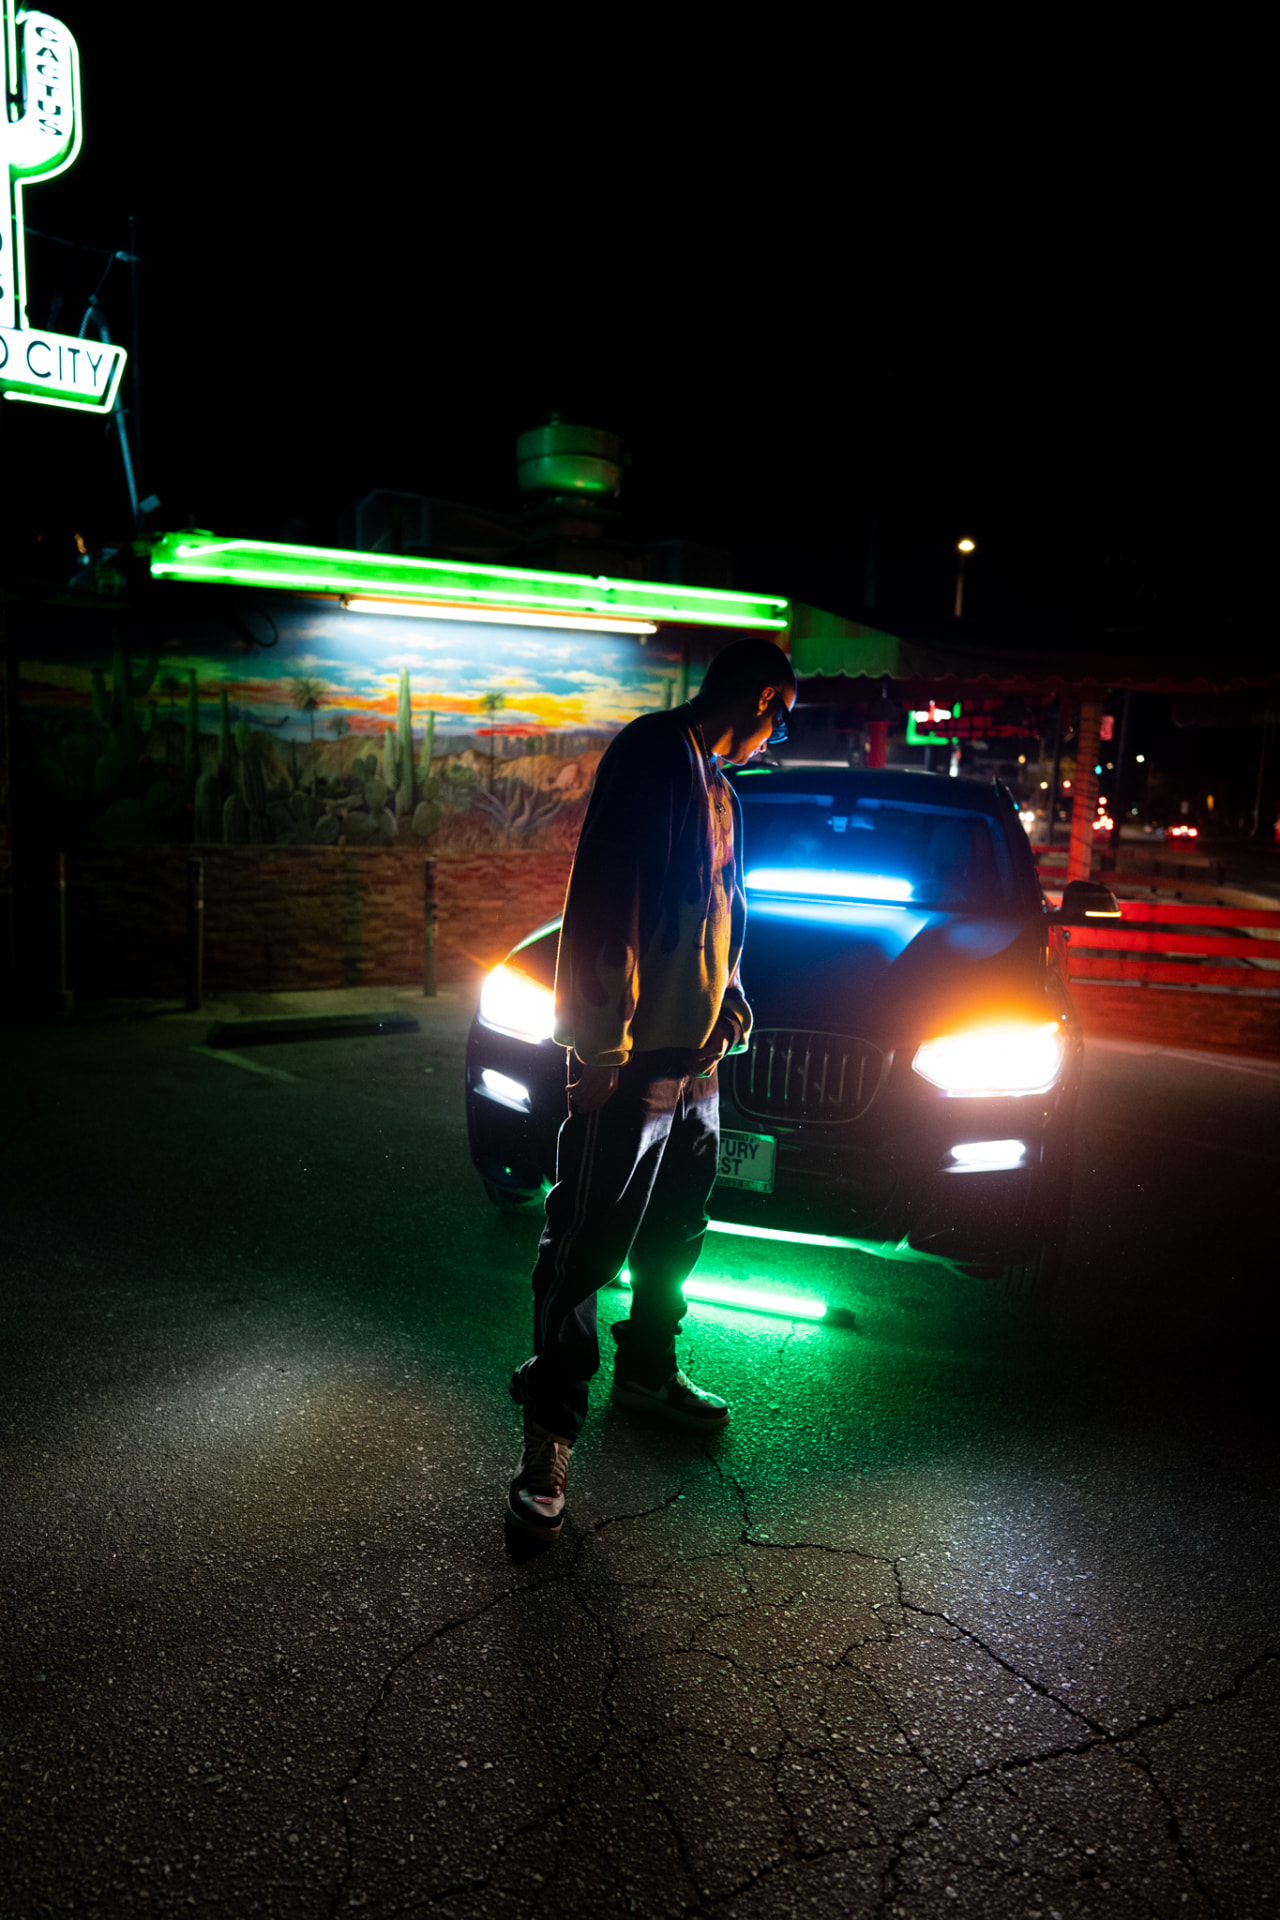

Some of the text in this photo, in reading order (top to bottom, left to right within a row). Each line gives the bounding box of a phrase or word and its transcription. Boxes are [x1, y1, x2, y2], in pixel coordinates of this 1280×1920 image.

[34, 26, 63, 136] CACTUS
[26, 340, 103, 388] CITY
[718, 1156, 742, 1176] ST
